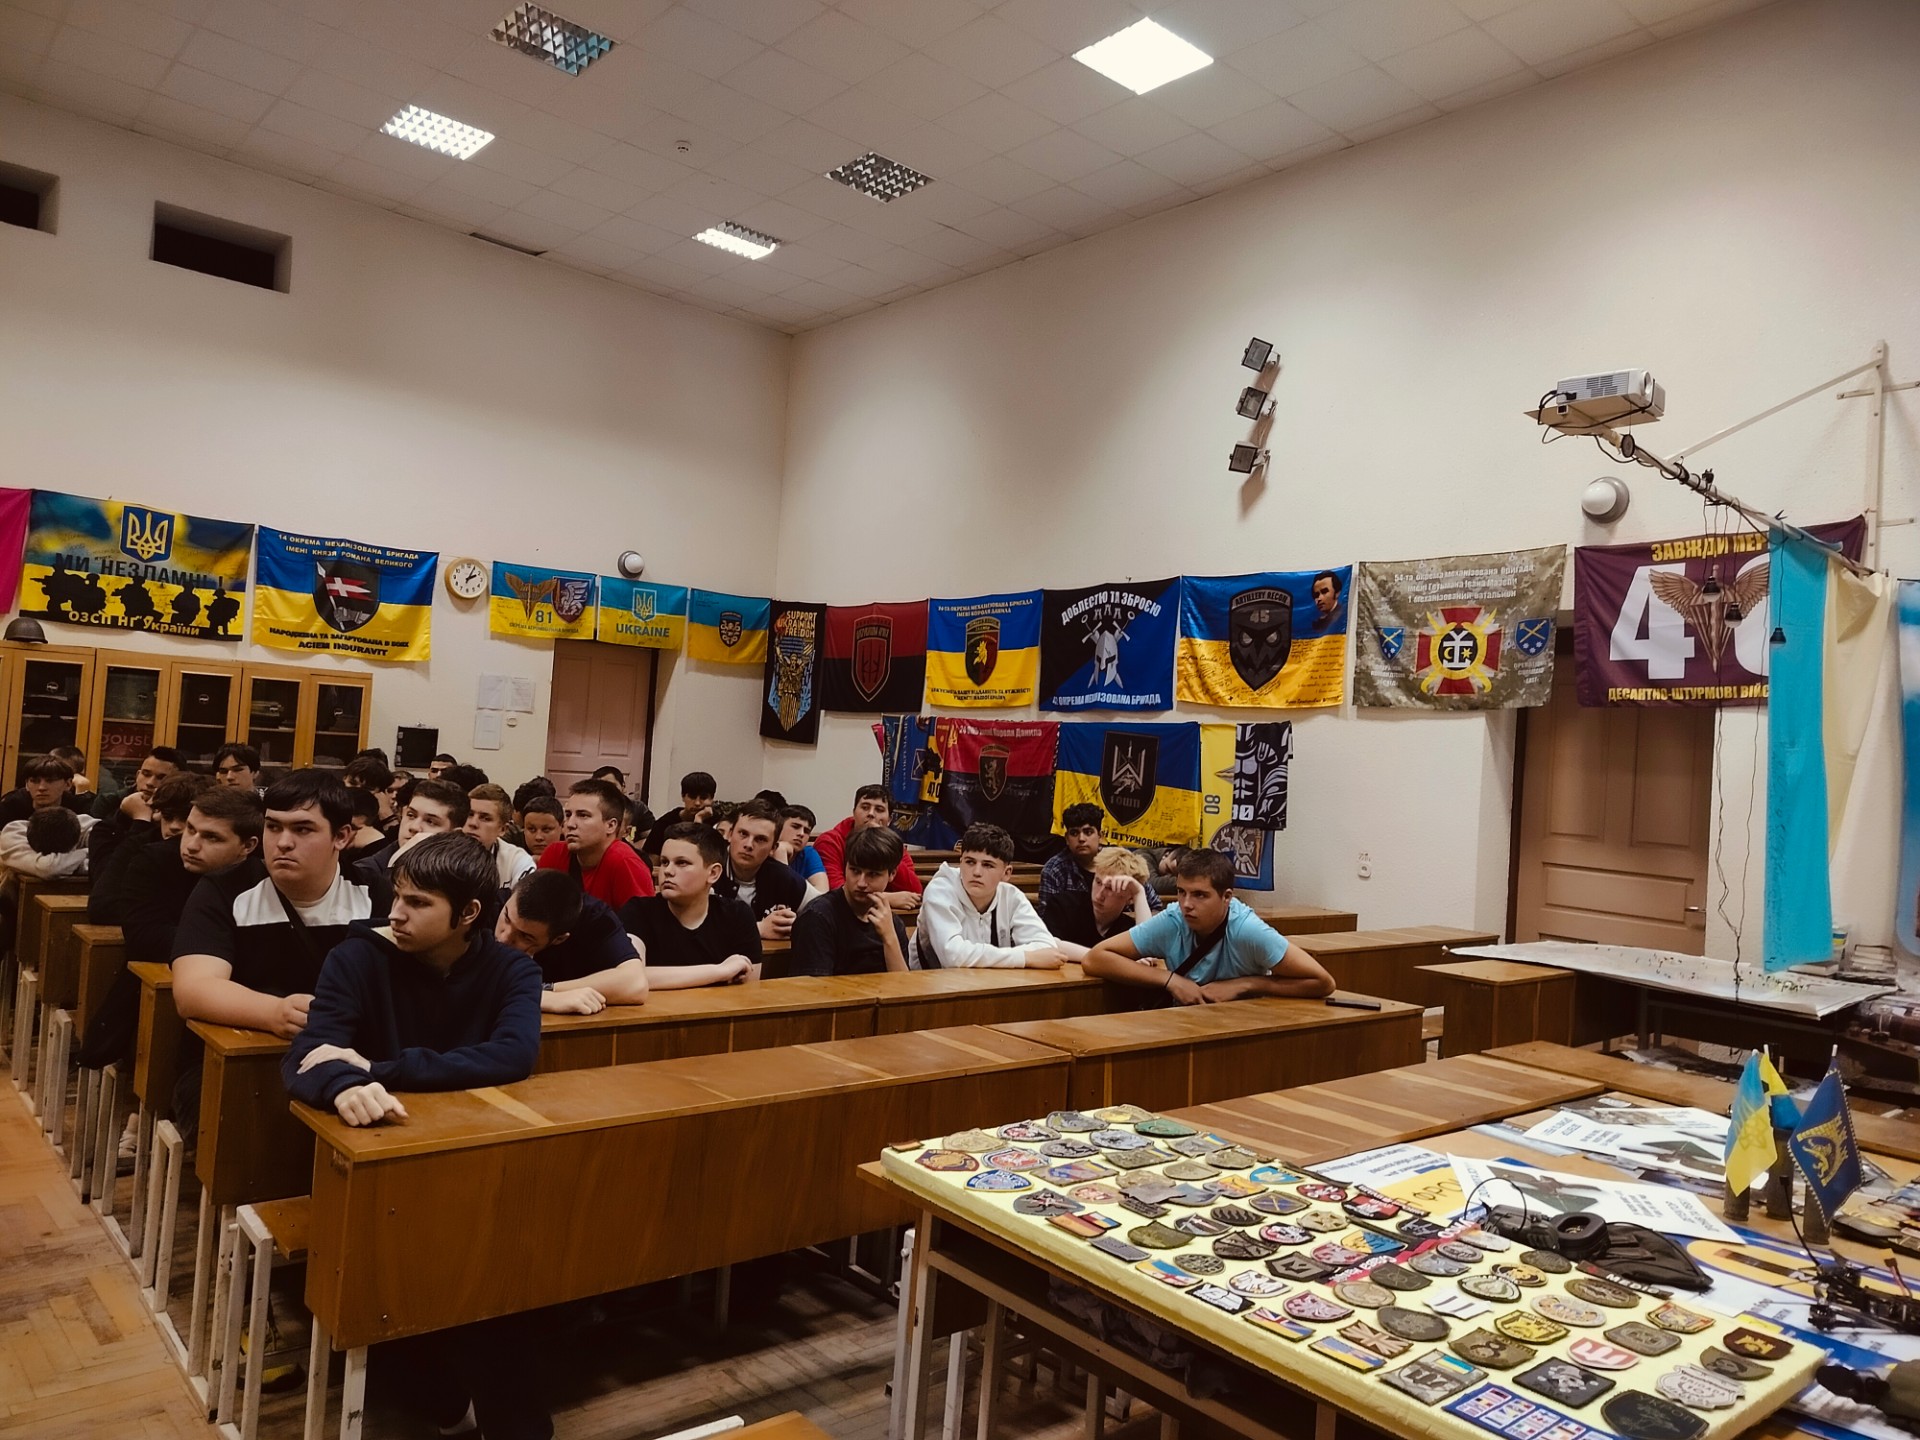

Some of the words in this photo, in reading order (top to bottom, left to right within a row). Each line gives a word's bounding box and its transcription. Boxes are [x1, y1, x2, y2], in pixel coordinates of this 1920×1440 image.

[289, 536, 321, 546] ОКРЕМА
[325, 540, 382, 555] МЕХАНІЗОВАНА
[386, 550, 419, 560] БРИГАДА
[1651, 536, 1729, 561] ЗАВЖДИ
[1733, 534, 1768, 553] ПЕР
[285, 545, 308, 554] ІМЕНІ
[312, 549, 337, 557] КНЯЗЯ
[341, 551, 371, 563] РОМАНА
[374, 558, 413, 568] ВЕЛИКОГО
[55, 553, 90, 573] МИ
[101, 559, 208, 589] НЕЗЛАМНІ
[1444, 567, 1498, 578] механізована
[1235, 591, 1265, 606] ARTILLERY
[1266, 591, 1288, 603] RECON
[786, 610, 818, 621] SUPPORT
[1061, 591, 1108, 626] ДОБЛЕСТЮ
[1110, 591, 1120, 603] ТА
[1121, 592, 1162, 617] ЗБРОЄЮ
[535, 610, 552, 624] 81
[777, 618, 816, 630] UKRAINIAN
[1250, 610, 1270, 623] 45
[143, 616, 200, 636] України
[615, 623, 670, 638] UKRAINE
[784, 628, 815, 638] FREEDOM
[298, 641, 330, 650] ACIEM
[333, 642, 389, 656] INDURAVIT
[1608, 685, 1738, 702] ДЕСАНТНО-ШТУРМОВІ
[1741, 683, 1769, 699] ВІЙС
[1015, 728, 1042, 738] Данила
[1203, 794, 1221, 815] 80
[1606, 1273, 1660, 1294] MEDIC
